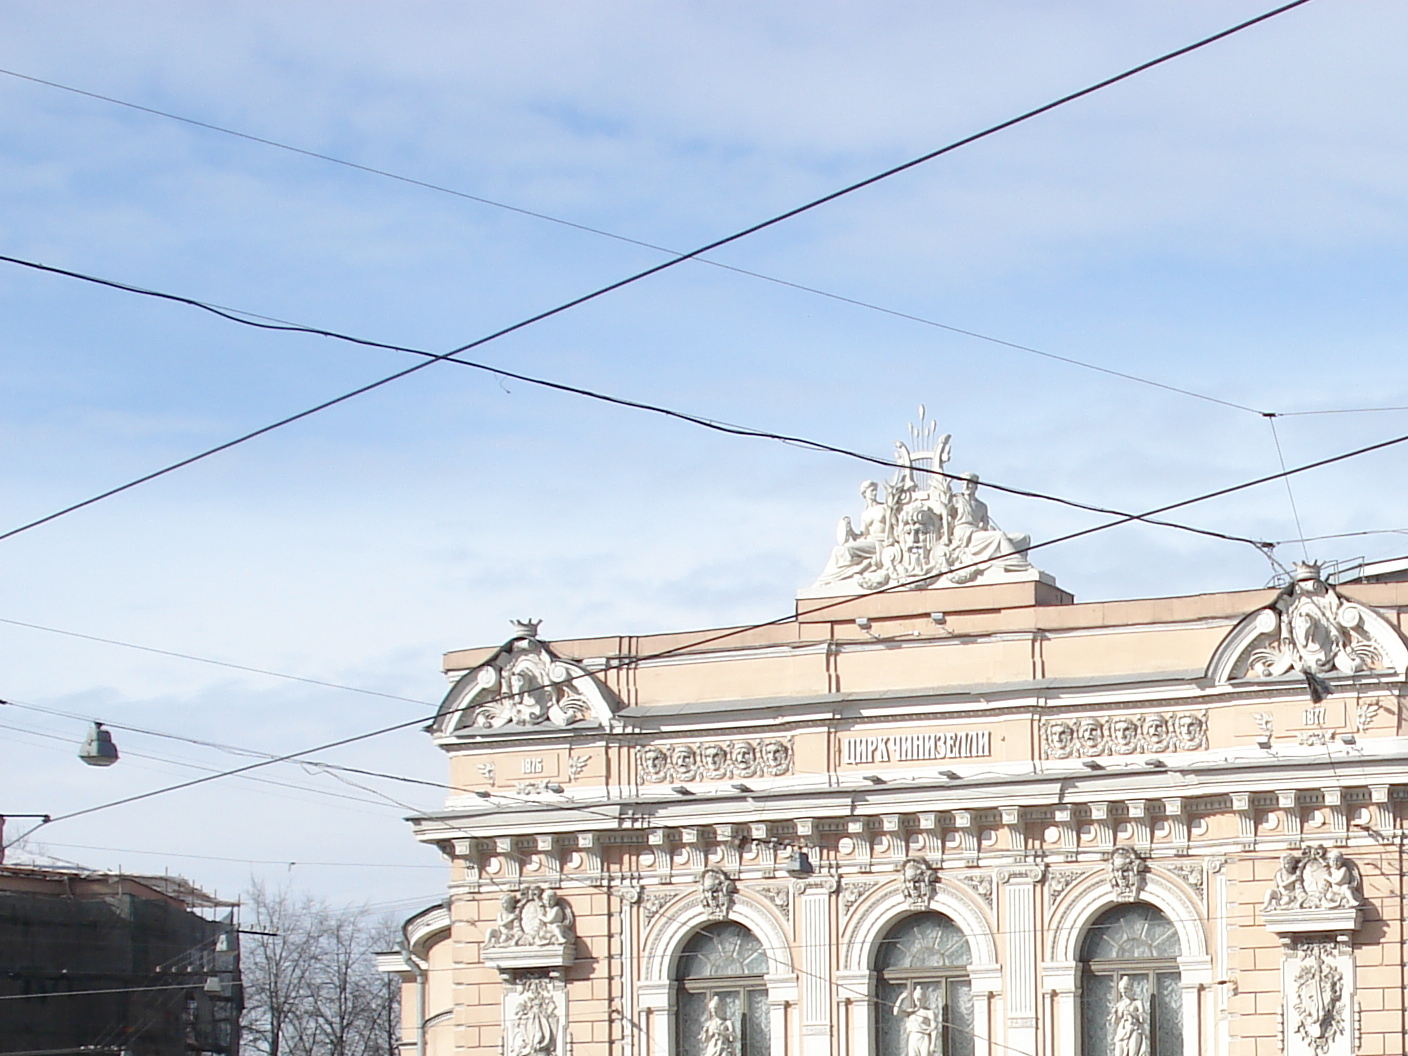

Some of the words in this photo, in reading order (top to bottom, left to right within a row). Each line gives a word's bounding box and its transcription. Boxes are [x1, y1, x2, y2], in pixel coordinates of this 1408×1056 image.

[844, 736, 890, 765] ЦИРК
[892, 730, 992, 762] ЧИНИЗЕЛЛИ
[521, 757, 544, 774] 1876
